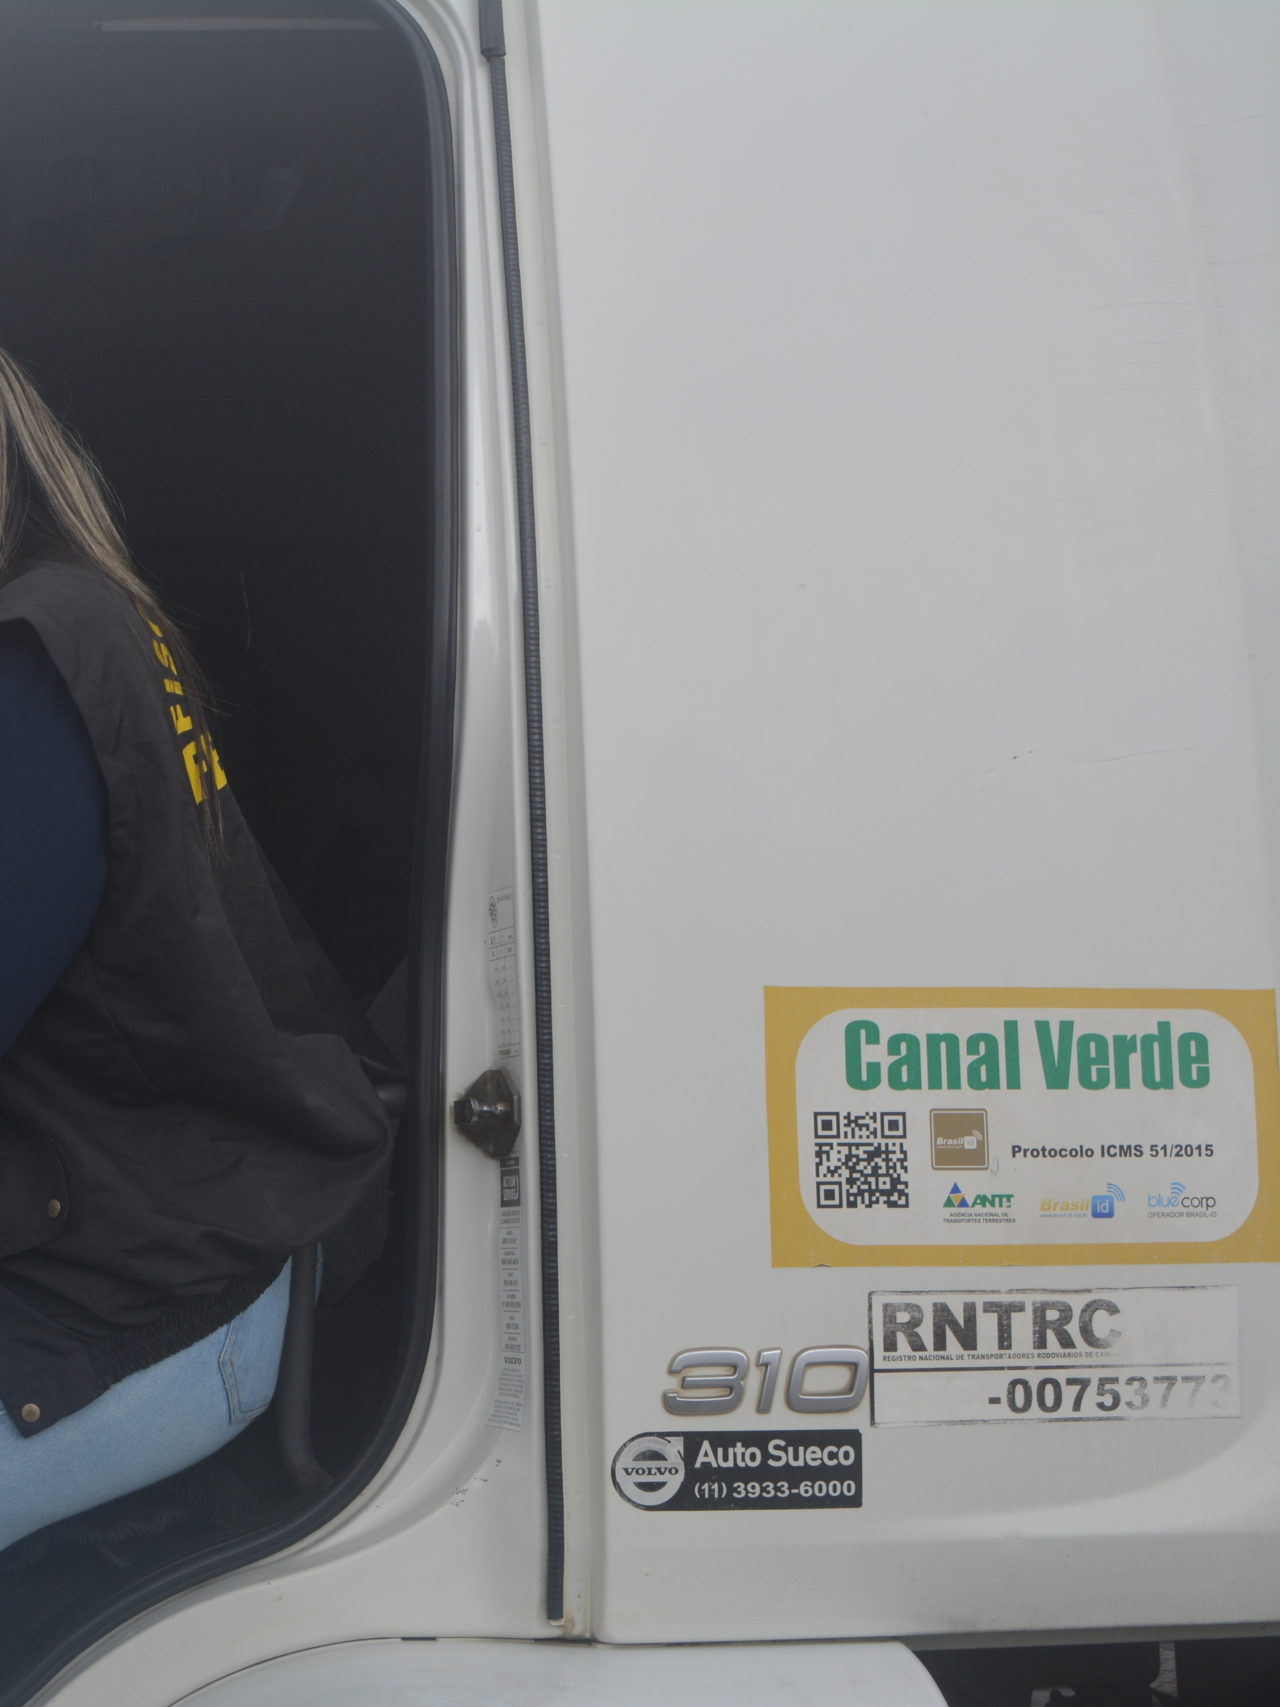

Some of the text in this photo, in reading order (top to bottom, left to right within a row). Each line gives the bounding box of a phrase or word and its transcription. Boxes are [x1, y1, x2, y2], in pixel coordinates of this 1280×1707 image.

[843, 1018, 1211, 1092] Canal Verde
[1011, 1143, 1215, 1159] Protocolo ICMS 51/2015
[1040, 1197, 1110, 1214] Brasil id
[1147, 1211, 1185, 1219] OPERADOR
[882, 1298, 1122, 1352] RNTRC
[882, 1354, 917, 1362] REGISTRO
[919, 1353, 954, 1361] NACIONAL
[955, 1353, 965, 1361] DE
[967, 1352, 1035, 1360] TRANSPORTADORES
[1084, 1351, 1094, 1359] DE
[663, 1345, 870, 1416] 310
[694, 1438, 856, 1468] Auto Sueco
[622, 1466, 679, 1477] VOLVO
[694, 1480, 857, 1499] (11) 3933-6000
